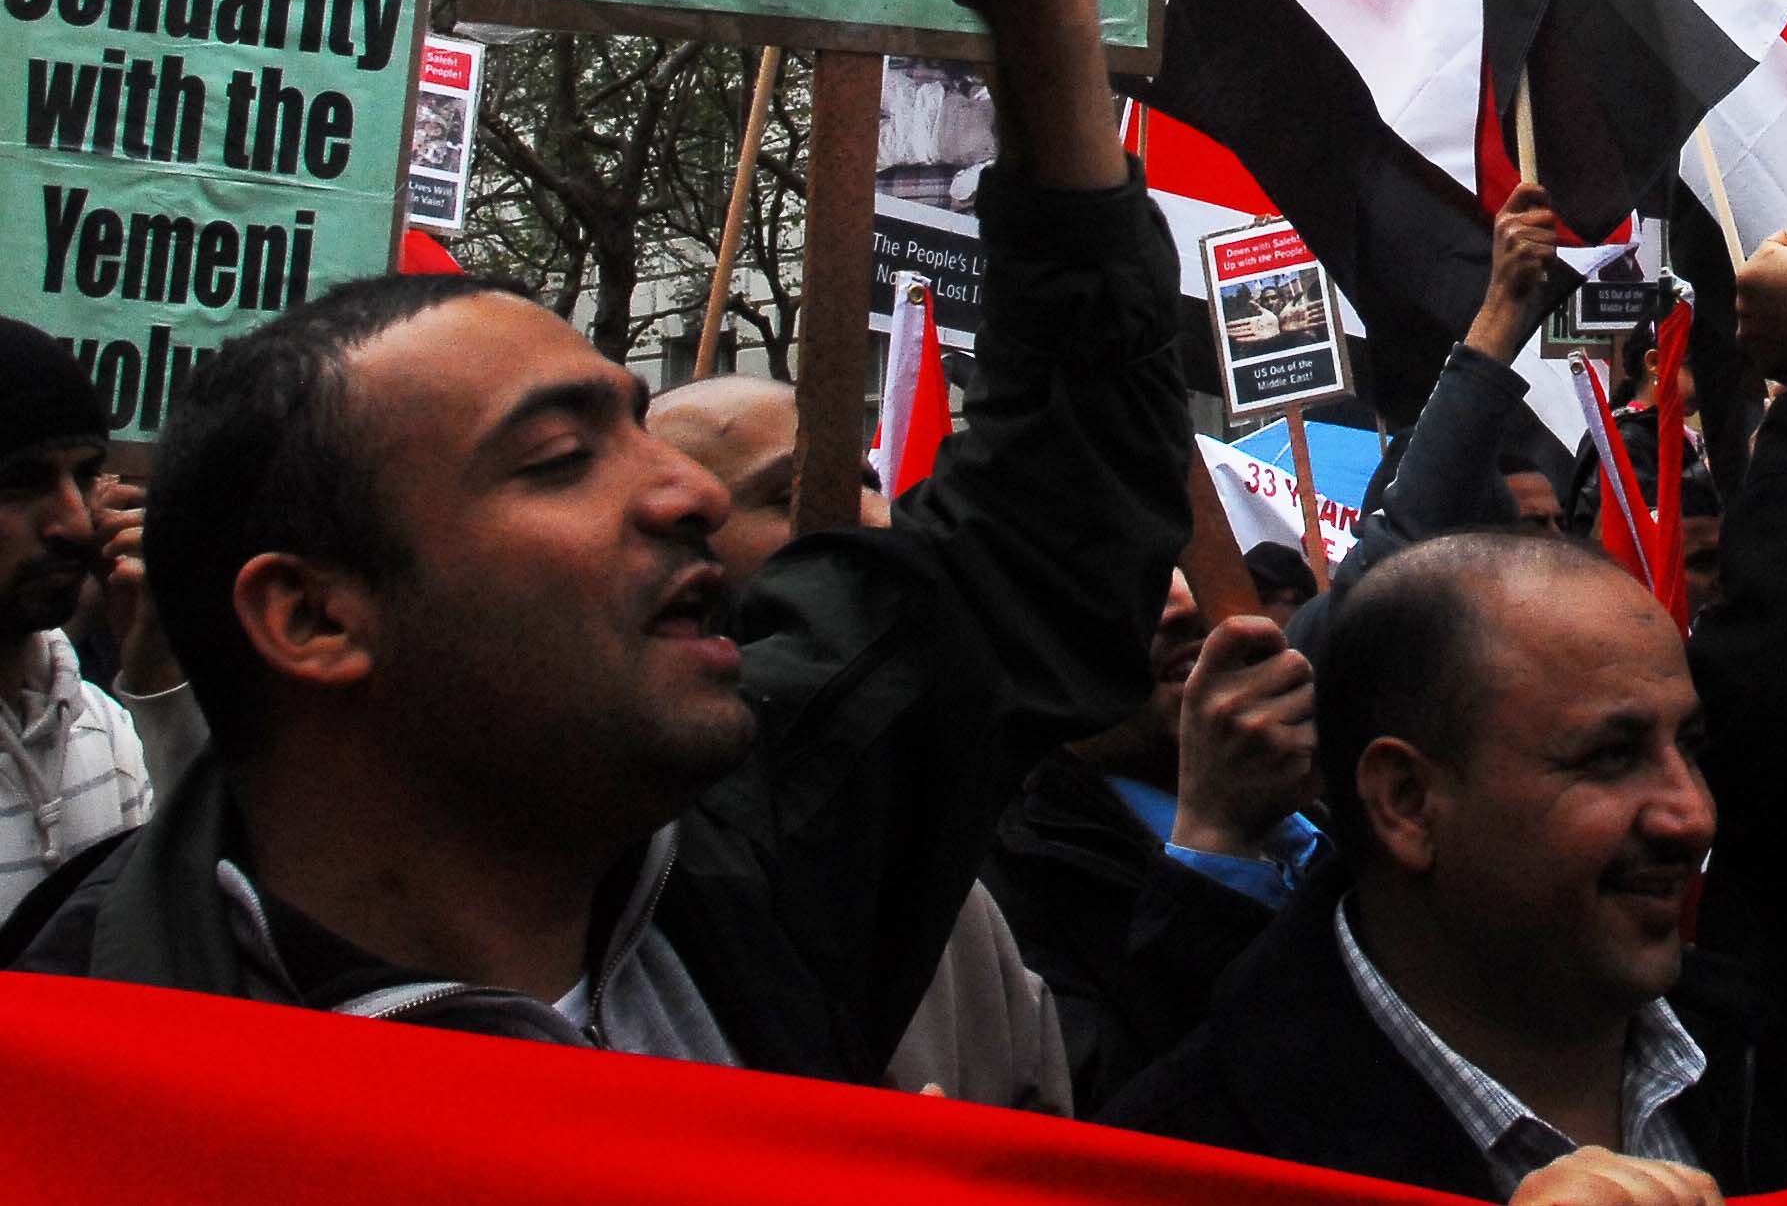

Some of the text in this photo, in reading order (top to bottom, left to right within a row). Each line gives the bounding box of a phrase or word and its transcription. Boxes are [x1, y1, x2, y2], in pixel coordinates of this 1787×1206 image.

[26, 48, 355, 180] with the
[42, 184, 317, 311] Yemeni
[872, 232, 900, 256] The
[906, 240, 967, 273] People's
[1223, 244, 1307, 271] Up with the People!
[1226, 247, 1251, 258] Down
[1252, 242, 1271, 251] with
[936, 277, 966, 302] Lost
[1253, 360, 1313, 379] US Out of the
[1257, 371, 1313, 390] Middle East!
[1245, 463, 1278, 498] 33
